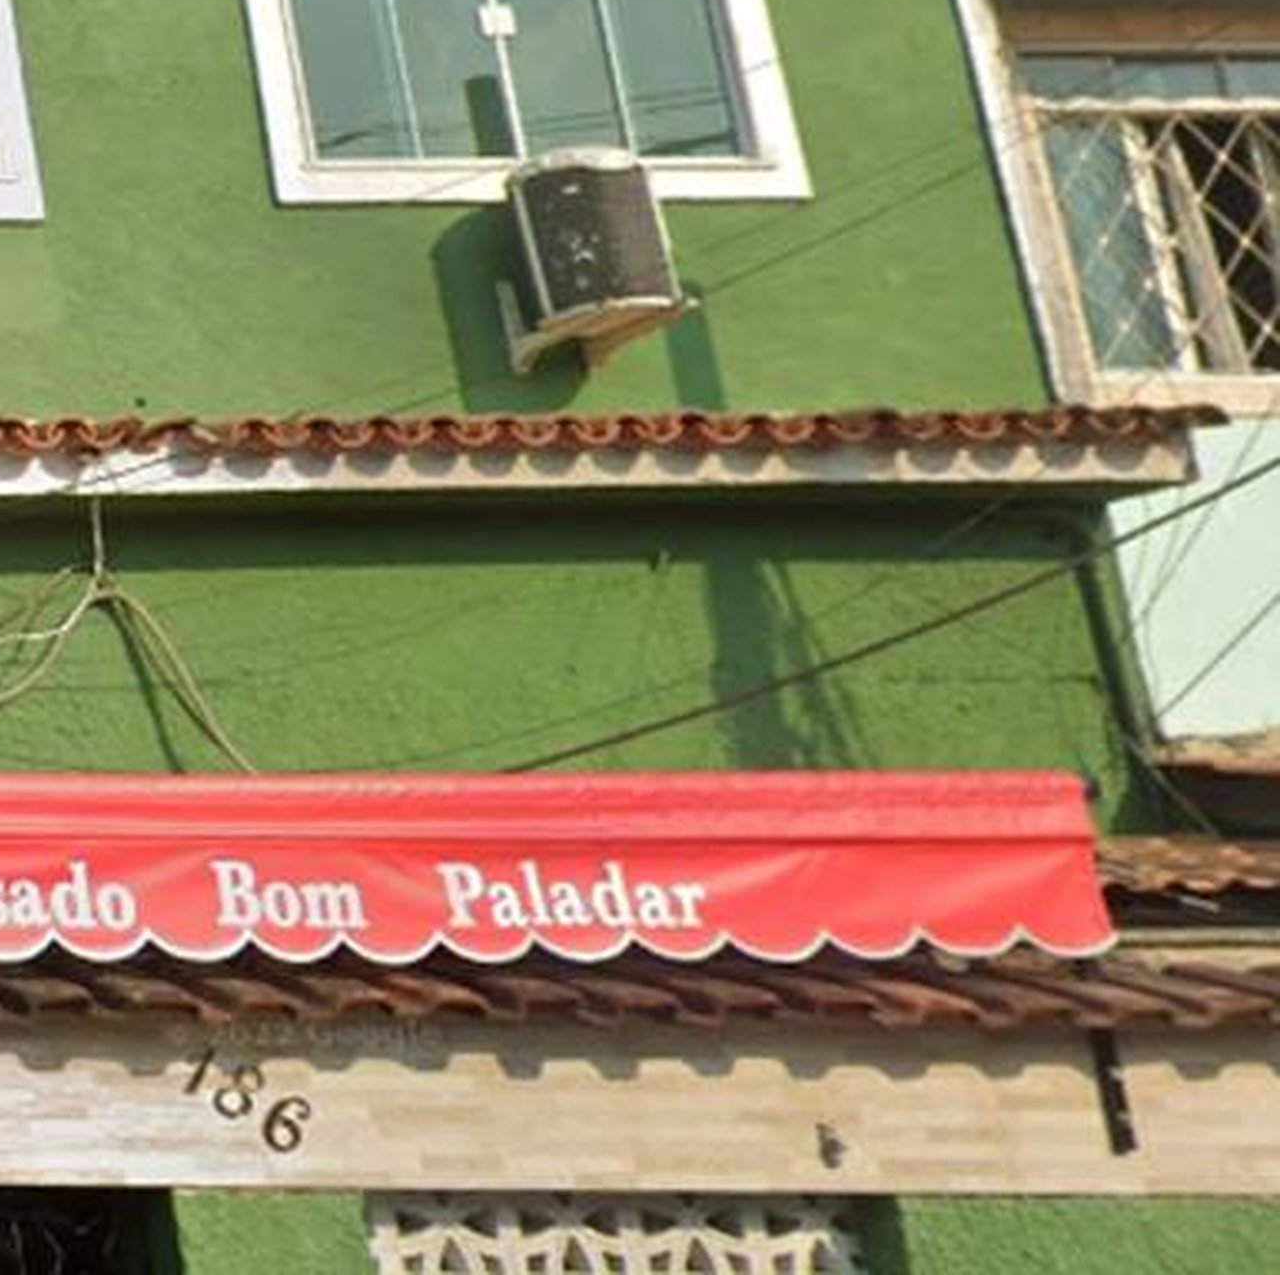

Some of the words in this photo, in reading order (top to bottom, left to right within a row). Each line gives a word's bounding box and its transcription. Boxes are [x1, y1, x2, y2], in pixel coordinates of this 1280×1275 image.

[210, 860, 369, 929] Bom
[437, 860, 705, 929] Paladar
[184, 1048, 312, 1153] 186
